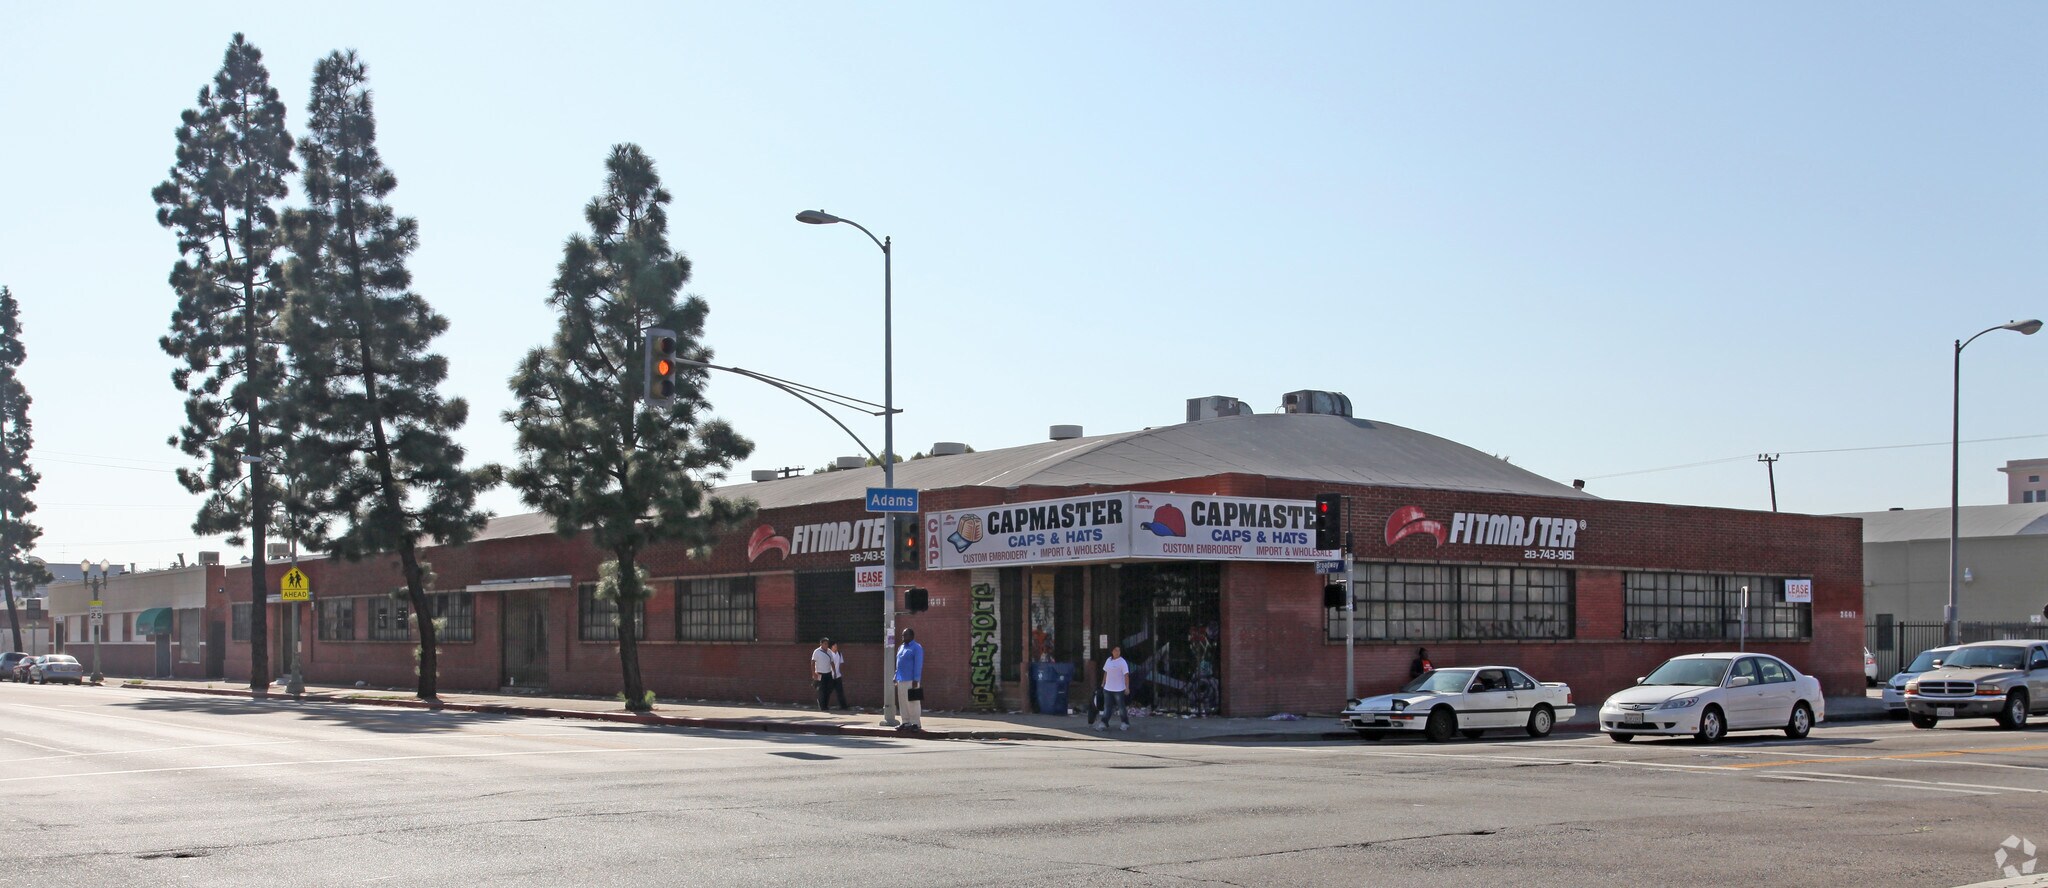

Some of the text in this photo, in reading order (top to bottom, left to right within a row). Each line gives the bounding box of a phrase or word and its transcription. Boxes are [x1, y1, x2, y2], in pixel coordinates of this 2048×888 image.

[871, 494, 913, 507] Adams
[987, 499, 1123, 535] CAPMASTER
[1191, 501, 1316, 530] CAPMASTE
[791, 517, 886, 555] FITMASTE
[928, 519, 939, 564] CAP
[1008, 528, 1103, 548] CAPS & HATS
[1211, 529, 1308, 545] CAPS & HATS
[963, 543, 1115, 563] CUSTOM EMBROIDERY IMPORT & WHOLESALE
[1163, 543, 1333, 558] CUSTOM EMBROIDERY IMPORT & WHOLESALE
[1524, 550, 1575, 560] 213-743-9151
[857, 571, 883, 584] LEASE
[1787, 584, 1809, 594] LEASE
